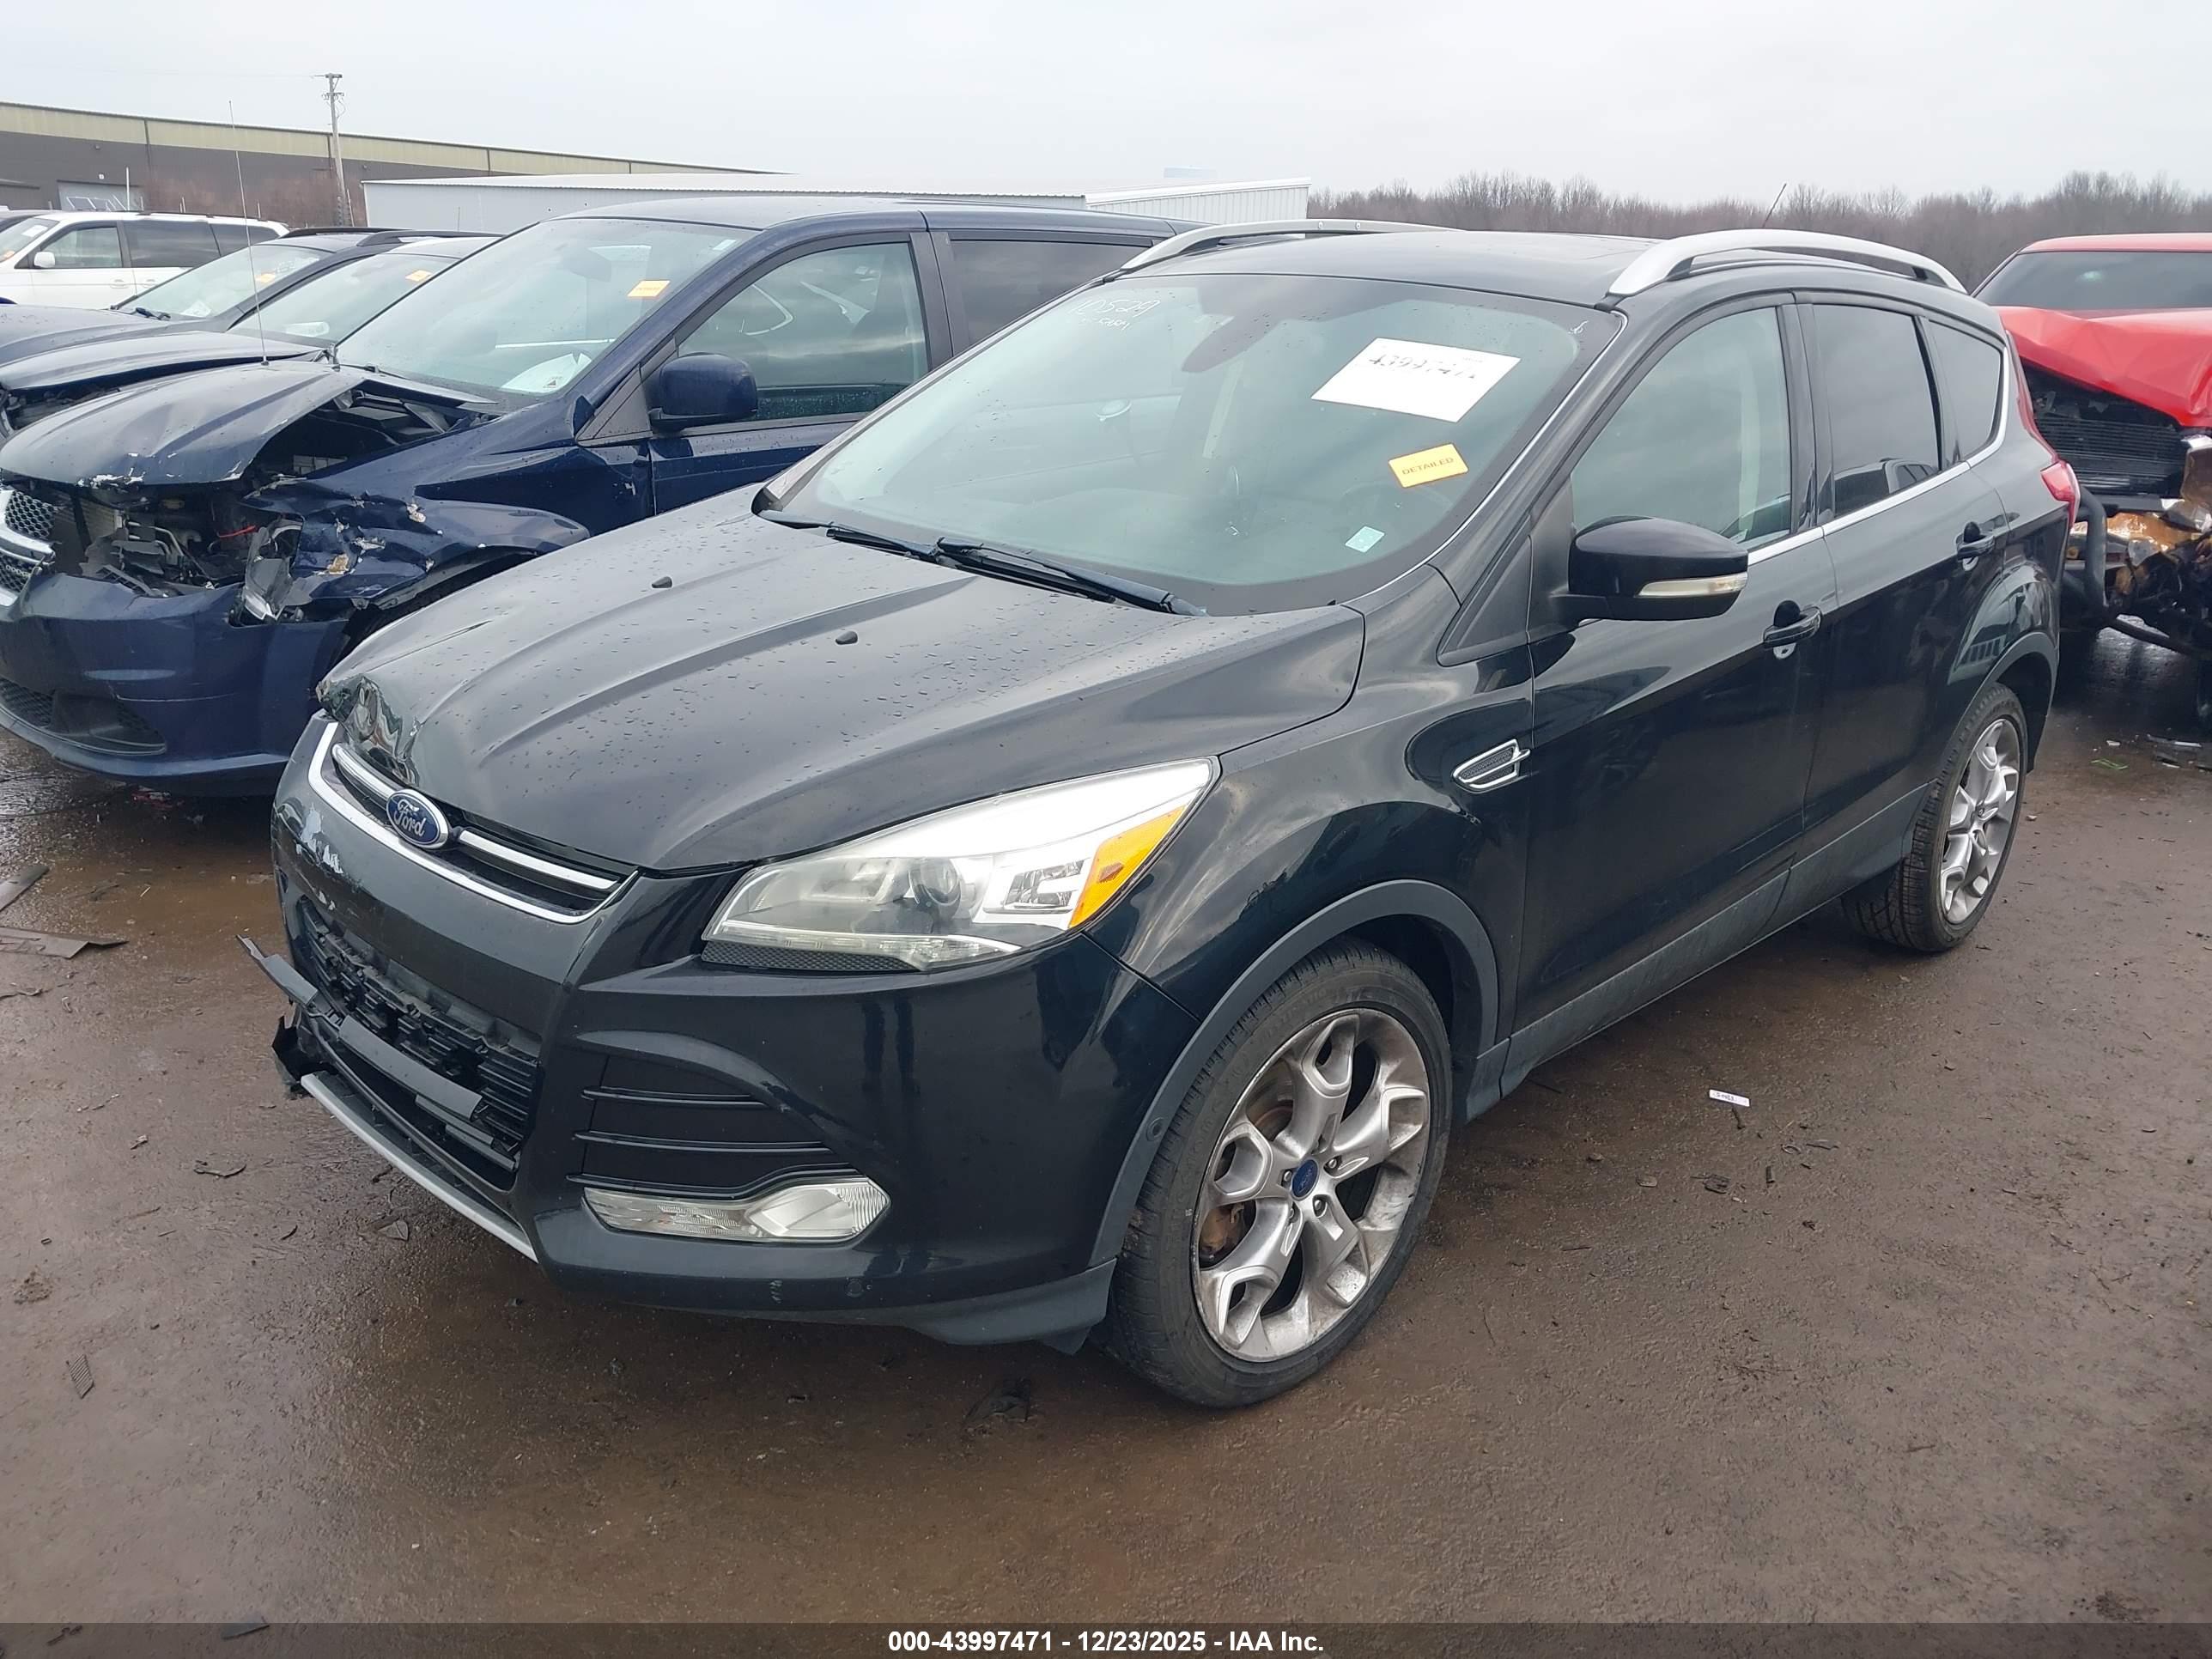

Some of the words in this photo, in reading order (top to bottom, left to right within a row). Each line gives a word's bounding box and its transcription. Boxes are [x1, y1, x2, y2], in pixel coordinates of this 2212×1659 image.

[1368, 353, 1478, 380] 43994
[1401, 457, 1455, 475] DETAILED
[394, 799, 428, 837] Ford
